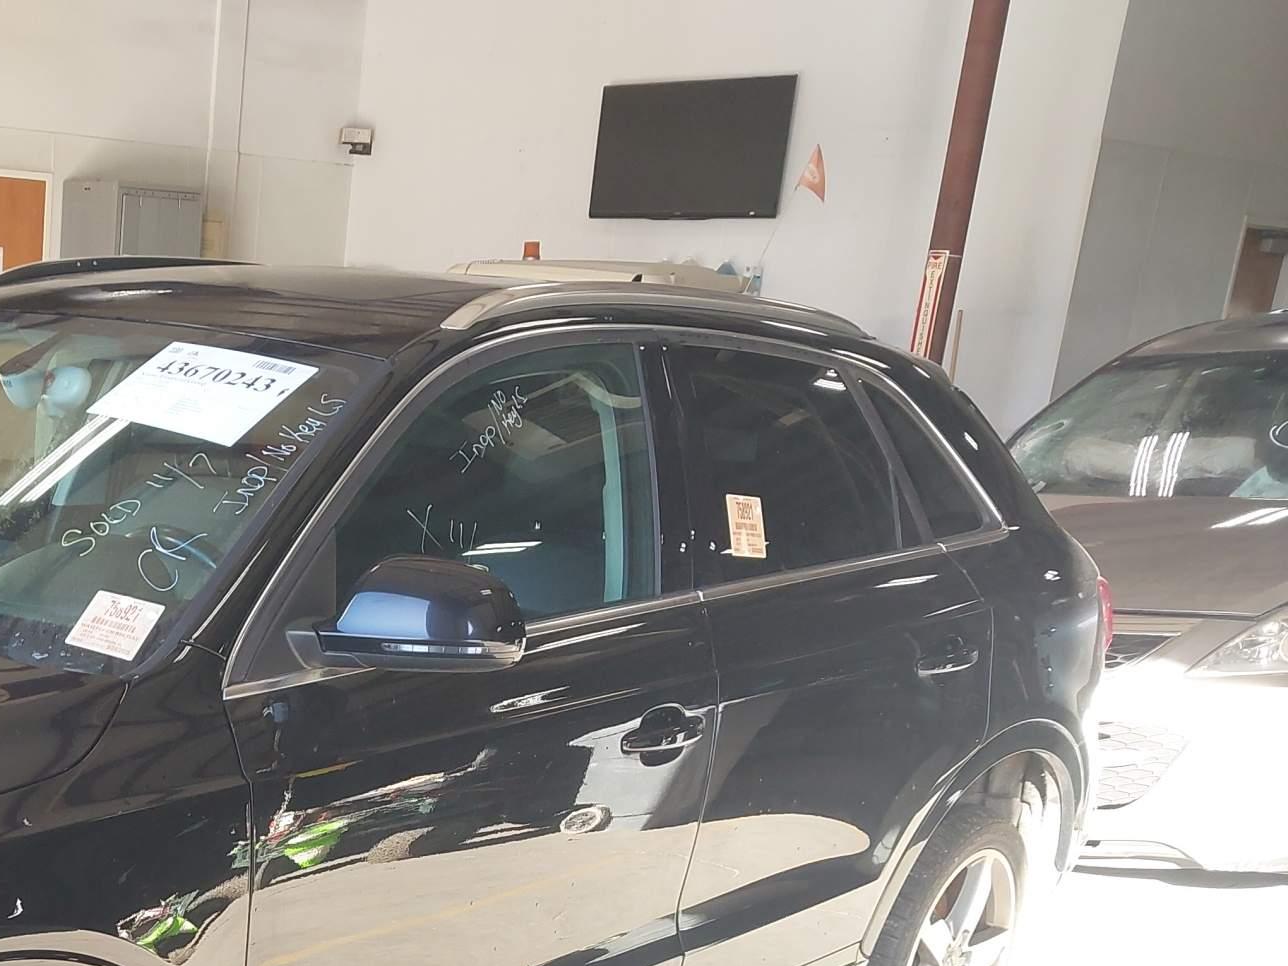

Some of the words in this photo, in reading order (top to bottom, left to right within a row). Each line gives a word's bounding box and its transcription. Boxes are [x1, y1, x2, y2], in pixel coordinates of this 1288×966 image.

[927, 261, 943, 270] FIRE
[916, 270, 936, 356] EXTINGUISHE
[155, 359, 278, 393] 43670243
[61, 499, 142, 557] SOLD
[145, 452, 216, 489] 11/7
